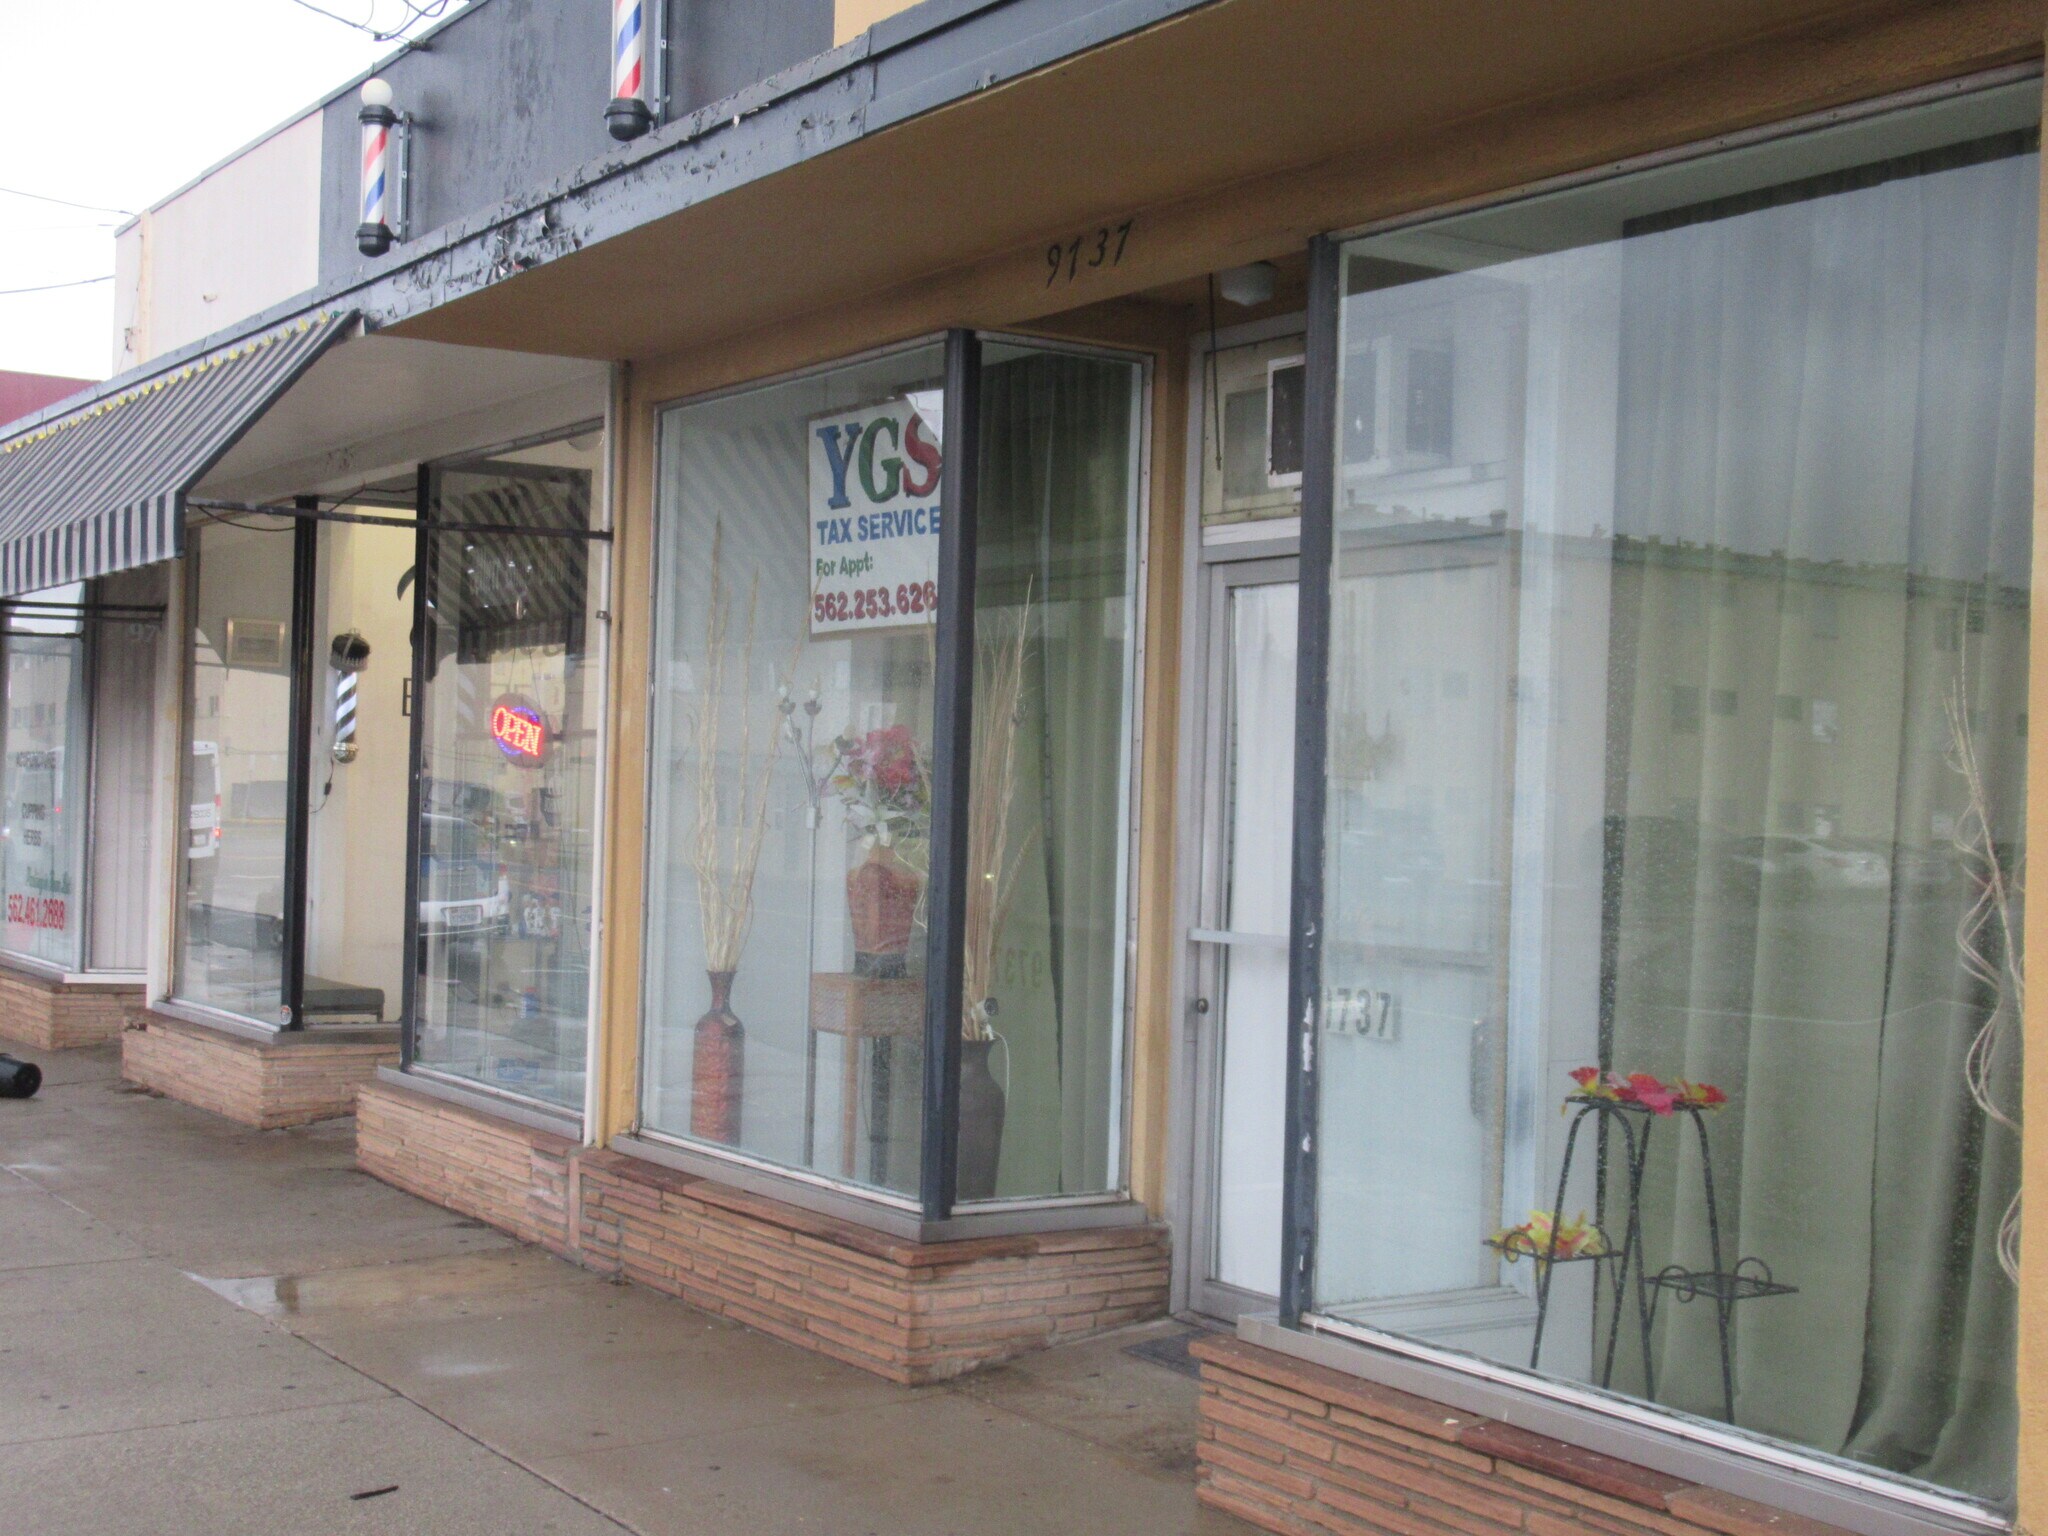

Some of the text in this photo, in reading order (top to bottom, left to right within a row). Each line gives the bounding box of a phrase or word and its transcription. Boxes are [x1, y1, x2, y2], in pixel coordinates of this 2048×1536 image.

[816, 411, 942, 510] YGS
[816, 506, 942, 546] TAX SERVICE
[816, 551, 874, 579] For Appt:
[814, 580, 938, 623] 562.253.626
[493, 706, 542, 756] OPEN
